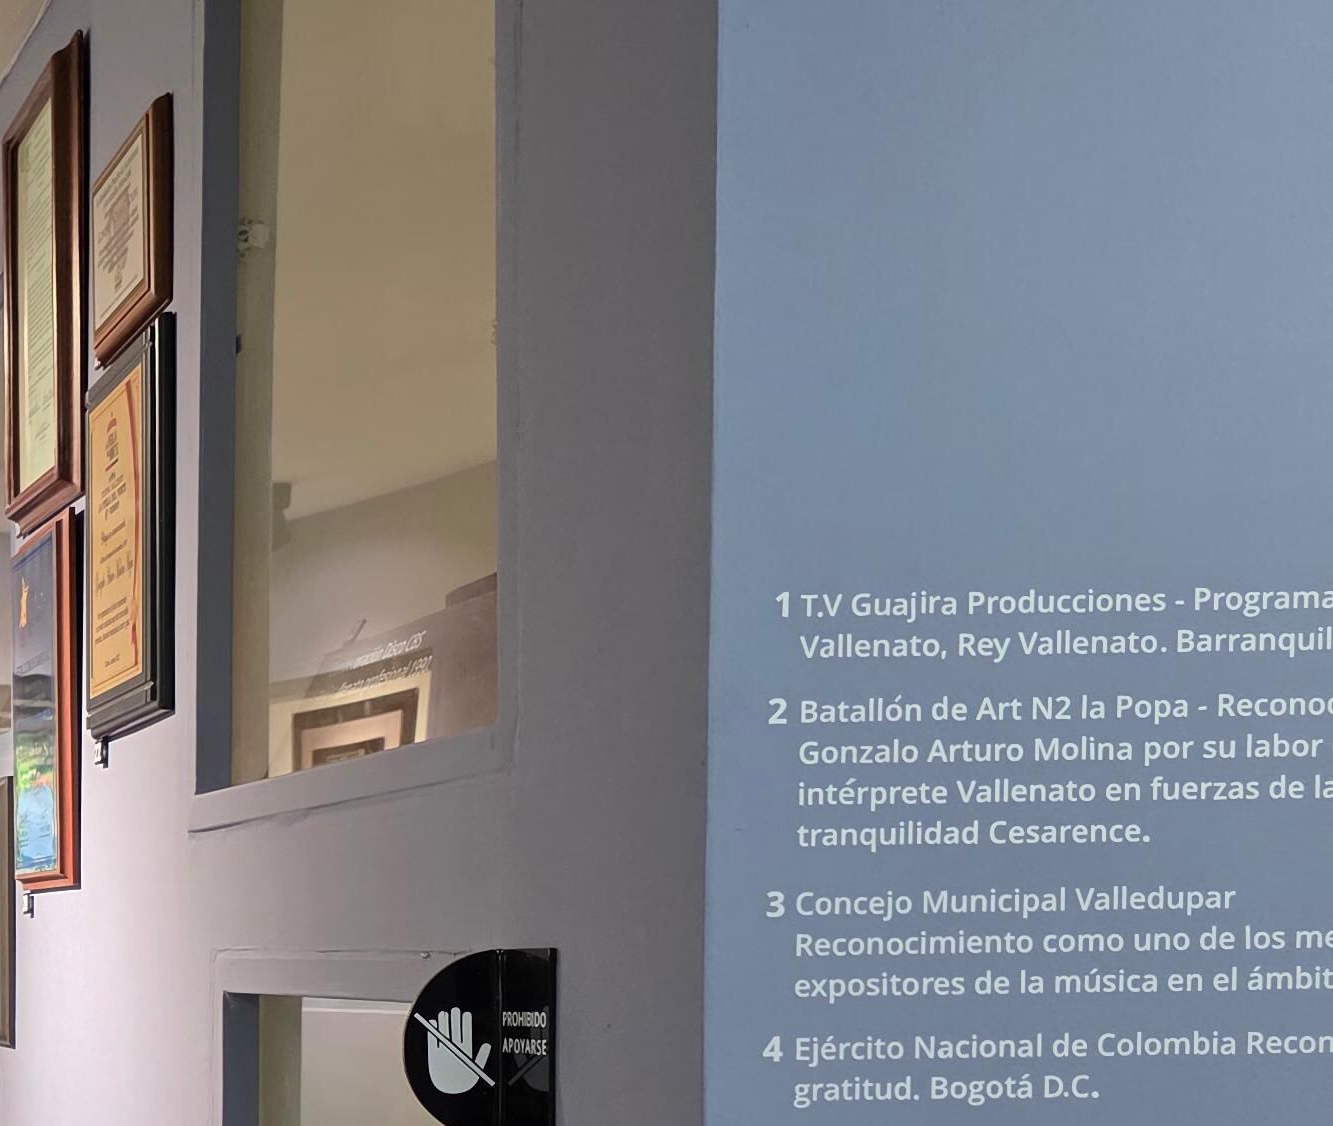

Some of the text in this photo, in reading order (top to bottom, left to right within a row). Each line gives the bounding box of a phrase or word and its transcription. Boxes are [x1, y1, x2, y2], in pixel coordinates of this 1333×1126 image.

[775, 591, 790, 618] 1
[800, 593, 843, 618] T.V
[851, 590, 957, 624] Guajira
[968, 588, 1167, 615] Producciones
[1194, 587, 1333, 618] Programa
[799, 625, 1332, 664] Vallenato, Rey Vallenato. Barranquil
[768, 697, 788, 725] 2
[800, 694, 922, 724] Batallón
[931, 695, 968, 722] de
[975, 696, 1023, 721] Art
[1032, 695, 1072, 721] N2
[1081, 694, 1106, 720] la
[1116, 695, 1189, 725] Popa
[796, 819, 1151, 853] tranquilidad Cesarence.
[766, 885, 1237, 922] 3 Concejo Municipal Valledupar
[502, 1011, 547, 1028] PROHIBIDO
[502, 1037, 547, 1056] APOYARSE
[762, 1030, 1333, 1068] 4 Ejército Nacional de Colombia Recon
[793, 1073, 1100, 1109] gratitud. Bogotá D.C.
